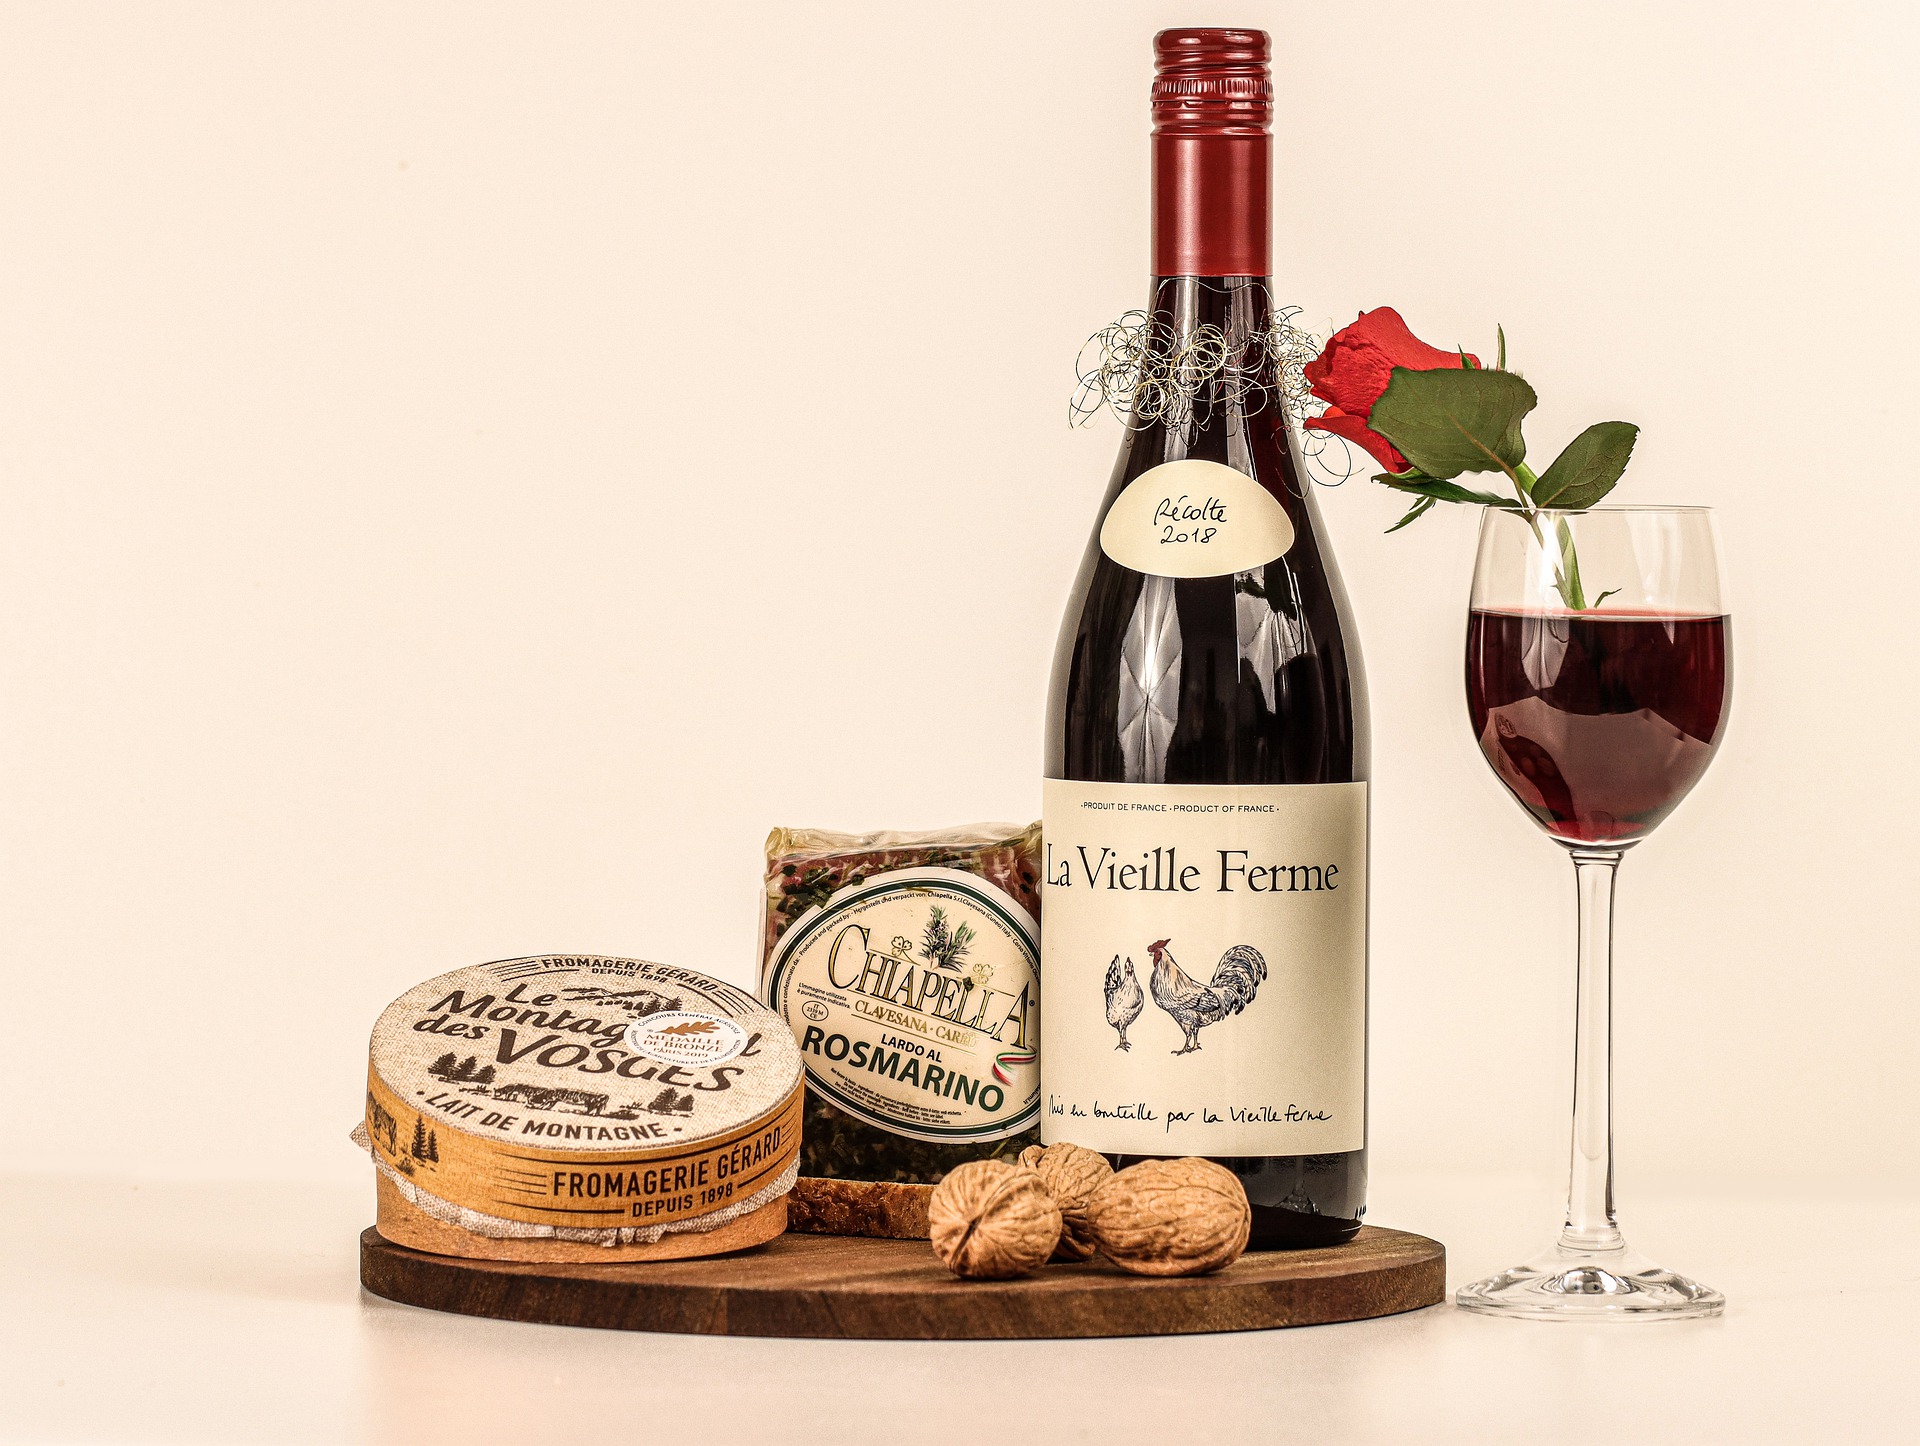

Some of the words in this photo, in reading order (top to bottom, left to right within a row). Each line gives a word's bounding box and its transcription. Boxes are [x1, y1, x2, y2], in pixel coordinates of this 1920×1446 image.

[1153, 495, 1228, 526] Récolte
[1160, 526, 1218, 544] 2018
[1084, 801, 1116, 810] PRODUIT
[1118, 803, 1128, 811] DE
[1131, 803, 1167, 812] FRANCE
[1173, 804, 1219, 813] PRODUCT
[1222, 805, 1235, 813] OF
[1238, 805, 1275, 813] FRANCE
[1046, 842, 1072, 887] La
[1076, 845, 1201, 892] Vieille
[1216, 850, 1340, 893] Ferme
[542, 958, 654, 973] FROMAGERIE
[592, 968, 636, 977] DEPUIS
[505, 983, 558, 1006] Le
[828, 924, 1030, 1050] CHIAPELLA
[412, 1014, 490, 1040] des
[854, 1000, 928, 1034] CLAVESANA
[664, 1042, 722, 1052] BRONZE
[880, 1034, 926, 1056] LARDO
[926, 1048, 942, 1063] AL
[801, 1025, 1004, 1112] ROSMARINO
[424, 1092, 484, 1119] LAIT
[480, 1112, 519, 1130] DE
[522, 1120, 667, 1141] MONTAGNE
[1166, 1112, 1195, 1134] par
[553, 1160, 709, 1198] FROMAGERIE
[717, 1126, 781, 1180] GÉRARD
[632, 1195, 693, 1218] DEPUIS
[701, 1182, 733, 1206] 1898
